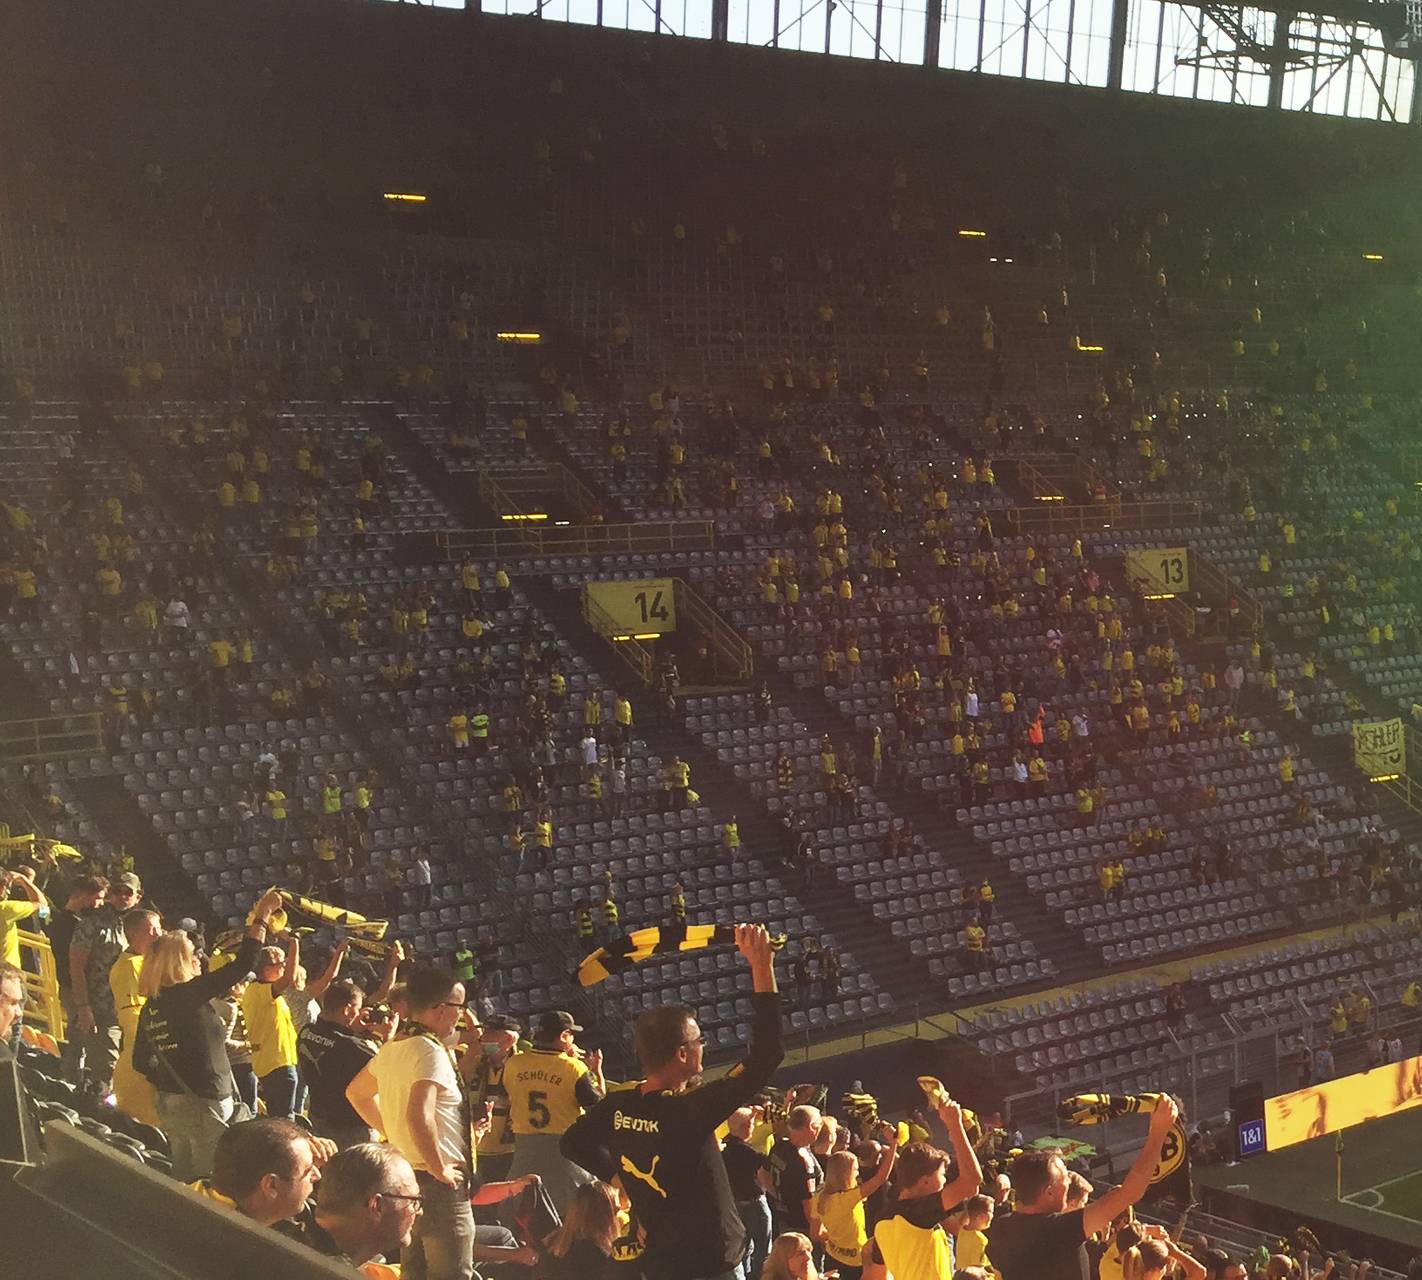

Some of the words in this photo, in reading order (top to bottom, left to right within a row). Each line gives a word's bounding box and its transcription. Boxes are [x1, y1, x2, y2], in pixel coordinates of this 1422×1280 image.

[1160, 558, 1184, 584] 13
[634, 591, 669, 623] 14
[528, 1091, 551, 1129] 5
[1242, 1127, 1262, 1146] 1&1
